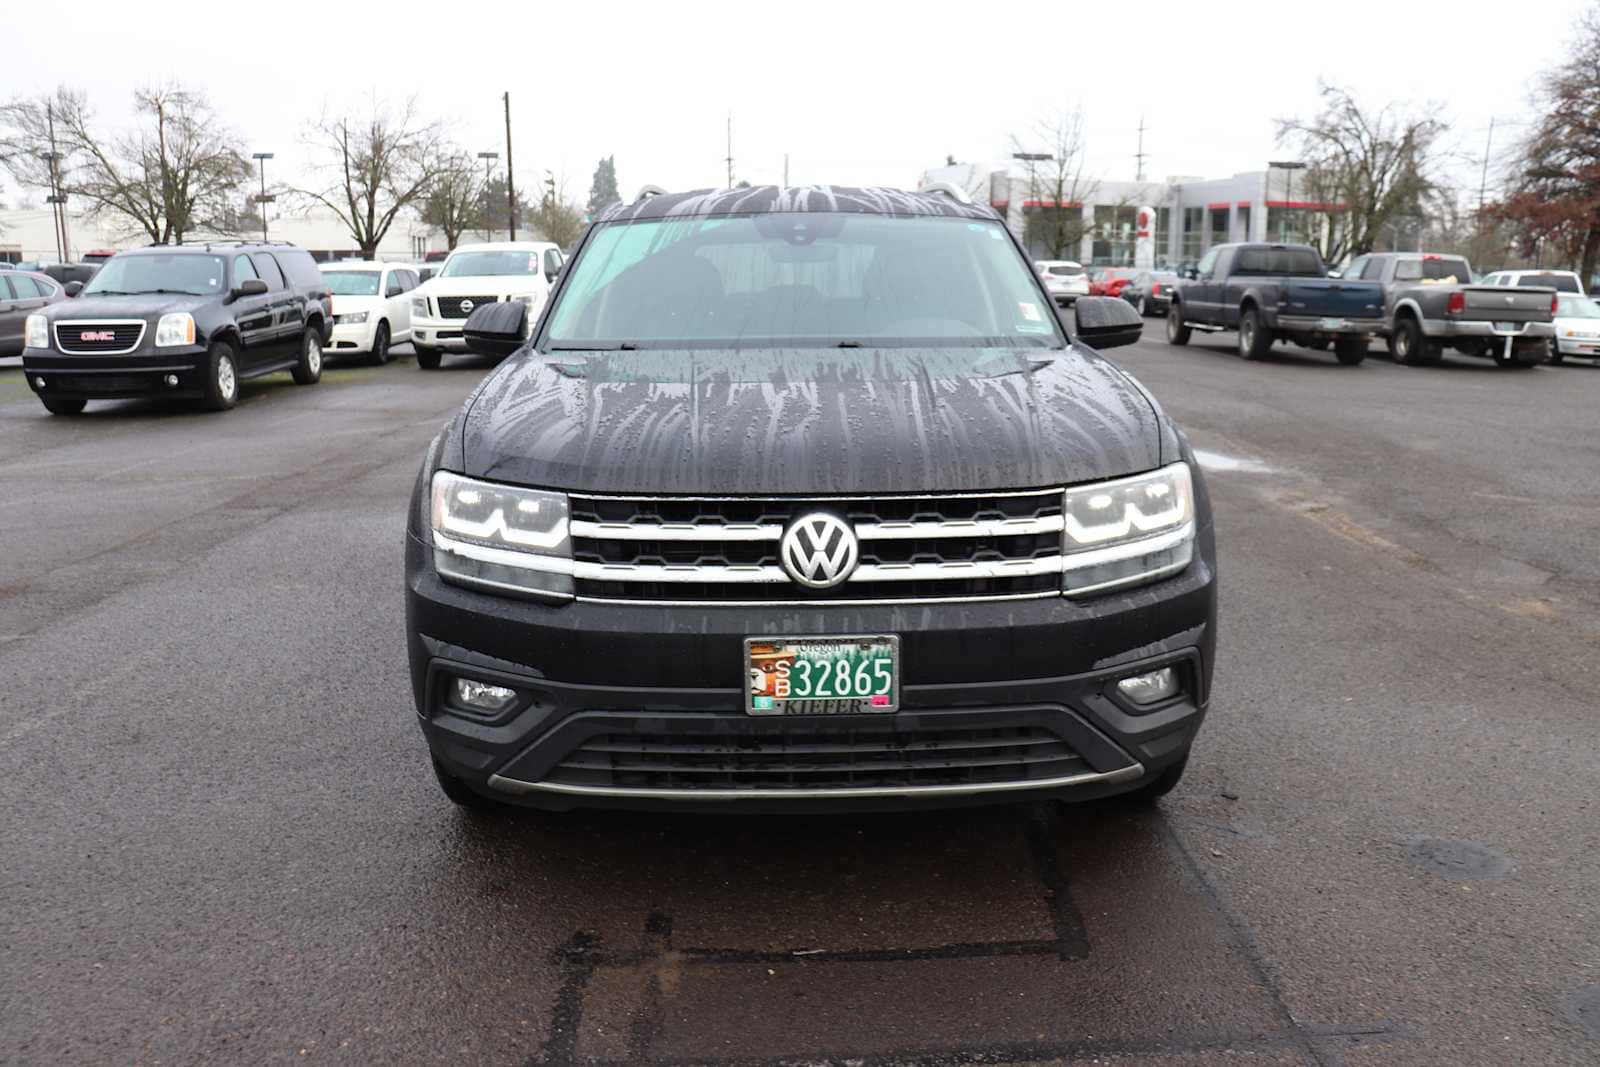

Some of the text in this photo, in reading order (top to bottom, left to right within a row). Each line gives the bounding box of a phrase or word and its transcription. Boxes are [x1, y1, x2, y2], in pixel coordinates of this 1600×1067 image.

[80, 331, 116, 341] GMC
[794, 659, 892, 696] 32865
[784, 699, 862, 714] KIEFER
